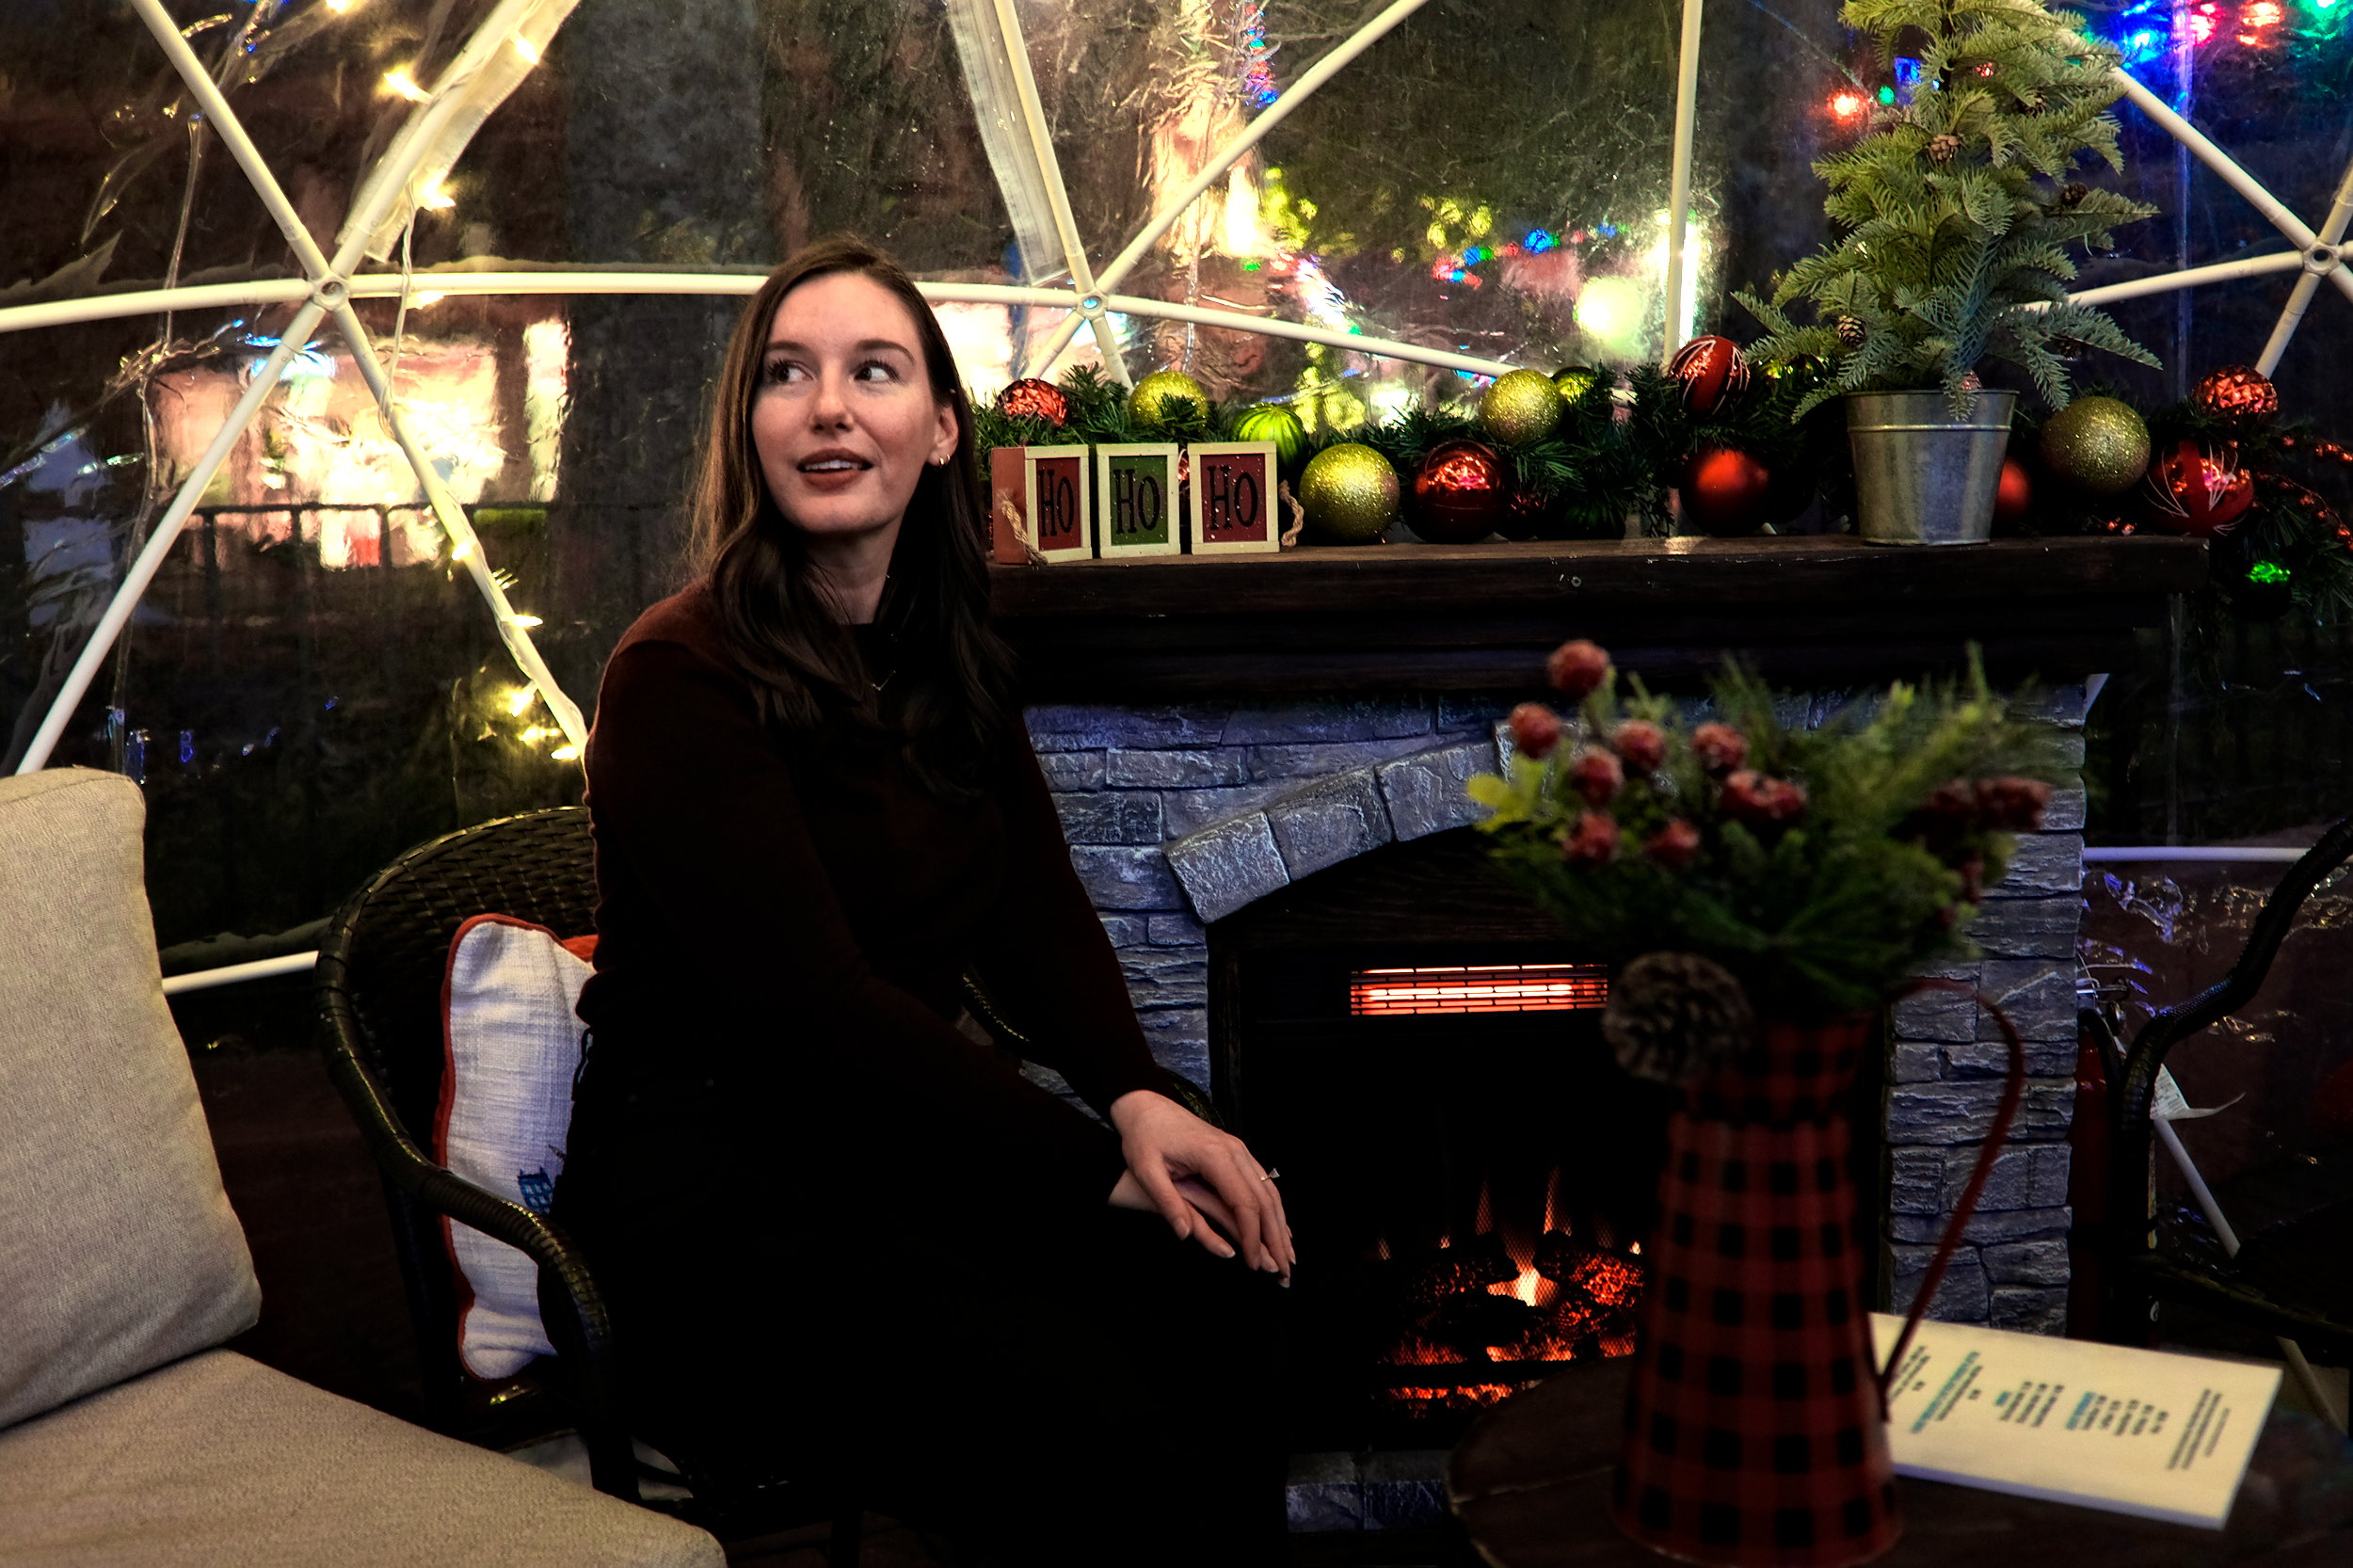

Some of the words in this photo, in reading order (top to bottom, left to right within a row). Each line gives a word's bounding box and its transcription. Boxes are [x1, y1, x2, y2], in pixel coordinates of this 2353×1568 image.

[1039, 470, 1075, 536] HO
[1114, 469, 1160, 534] HO
[1208, 465, 1258, 530] HO
